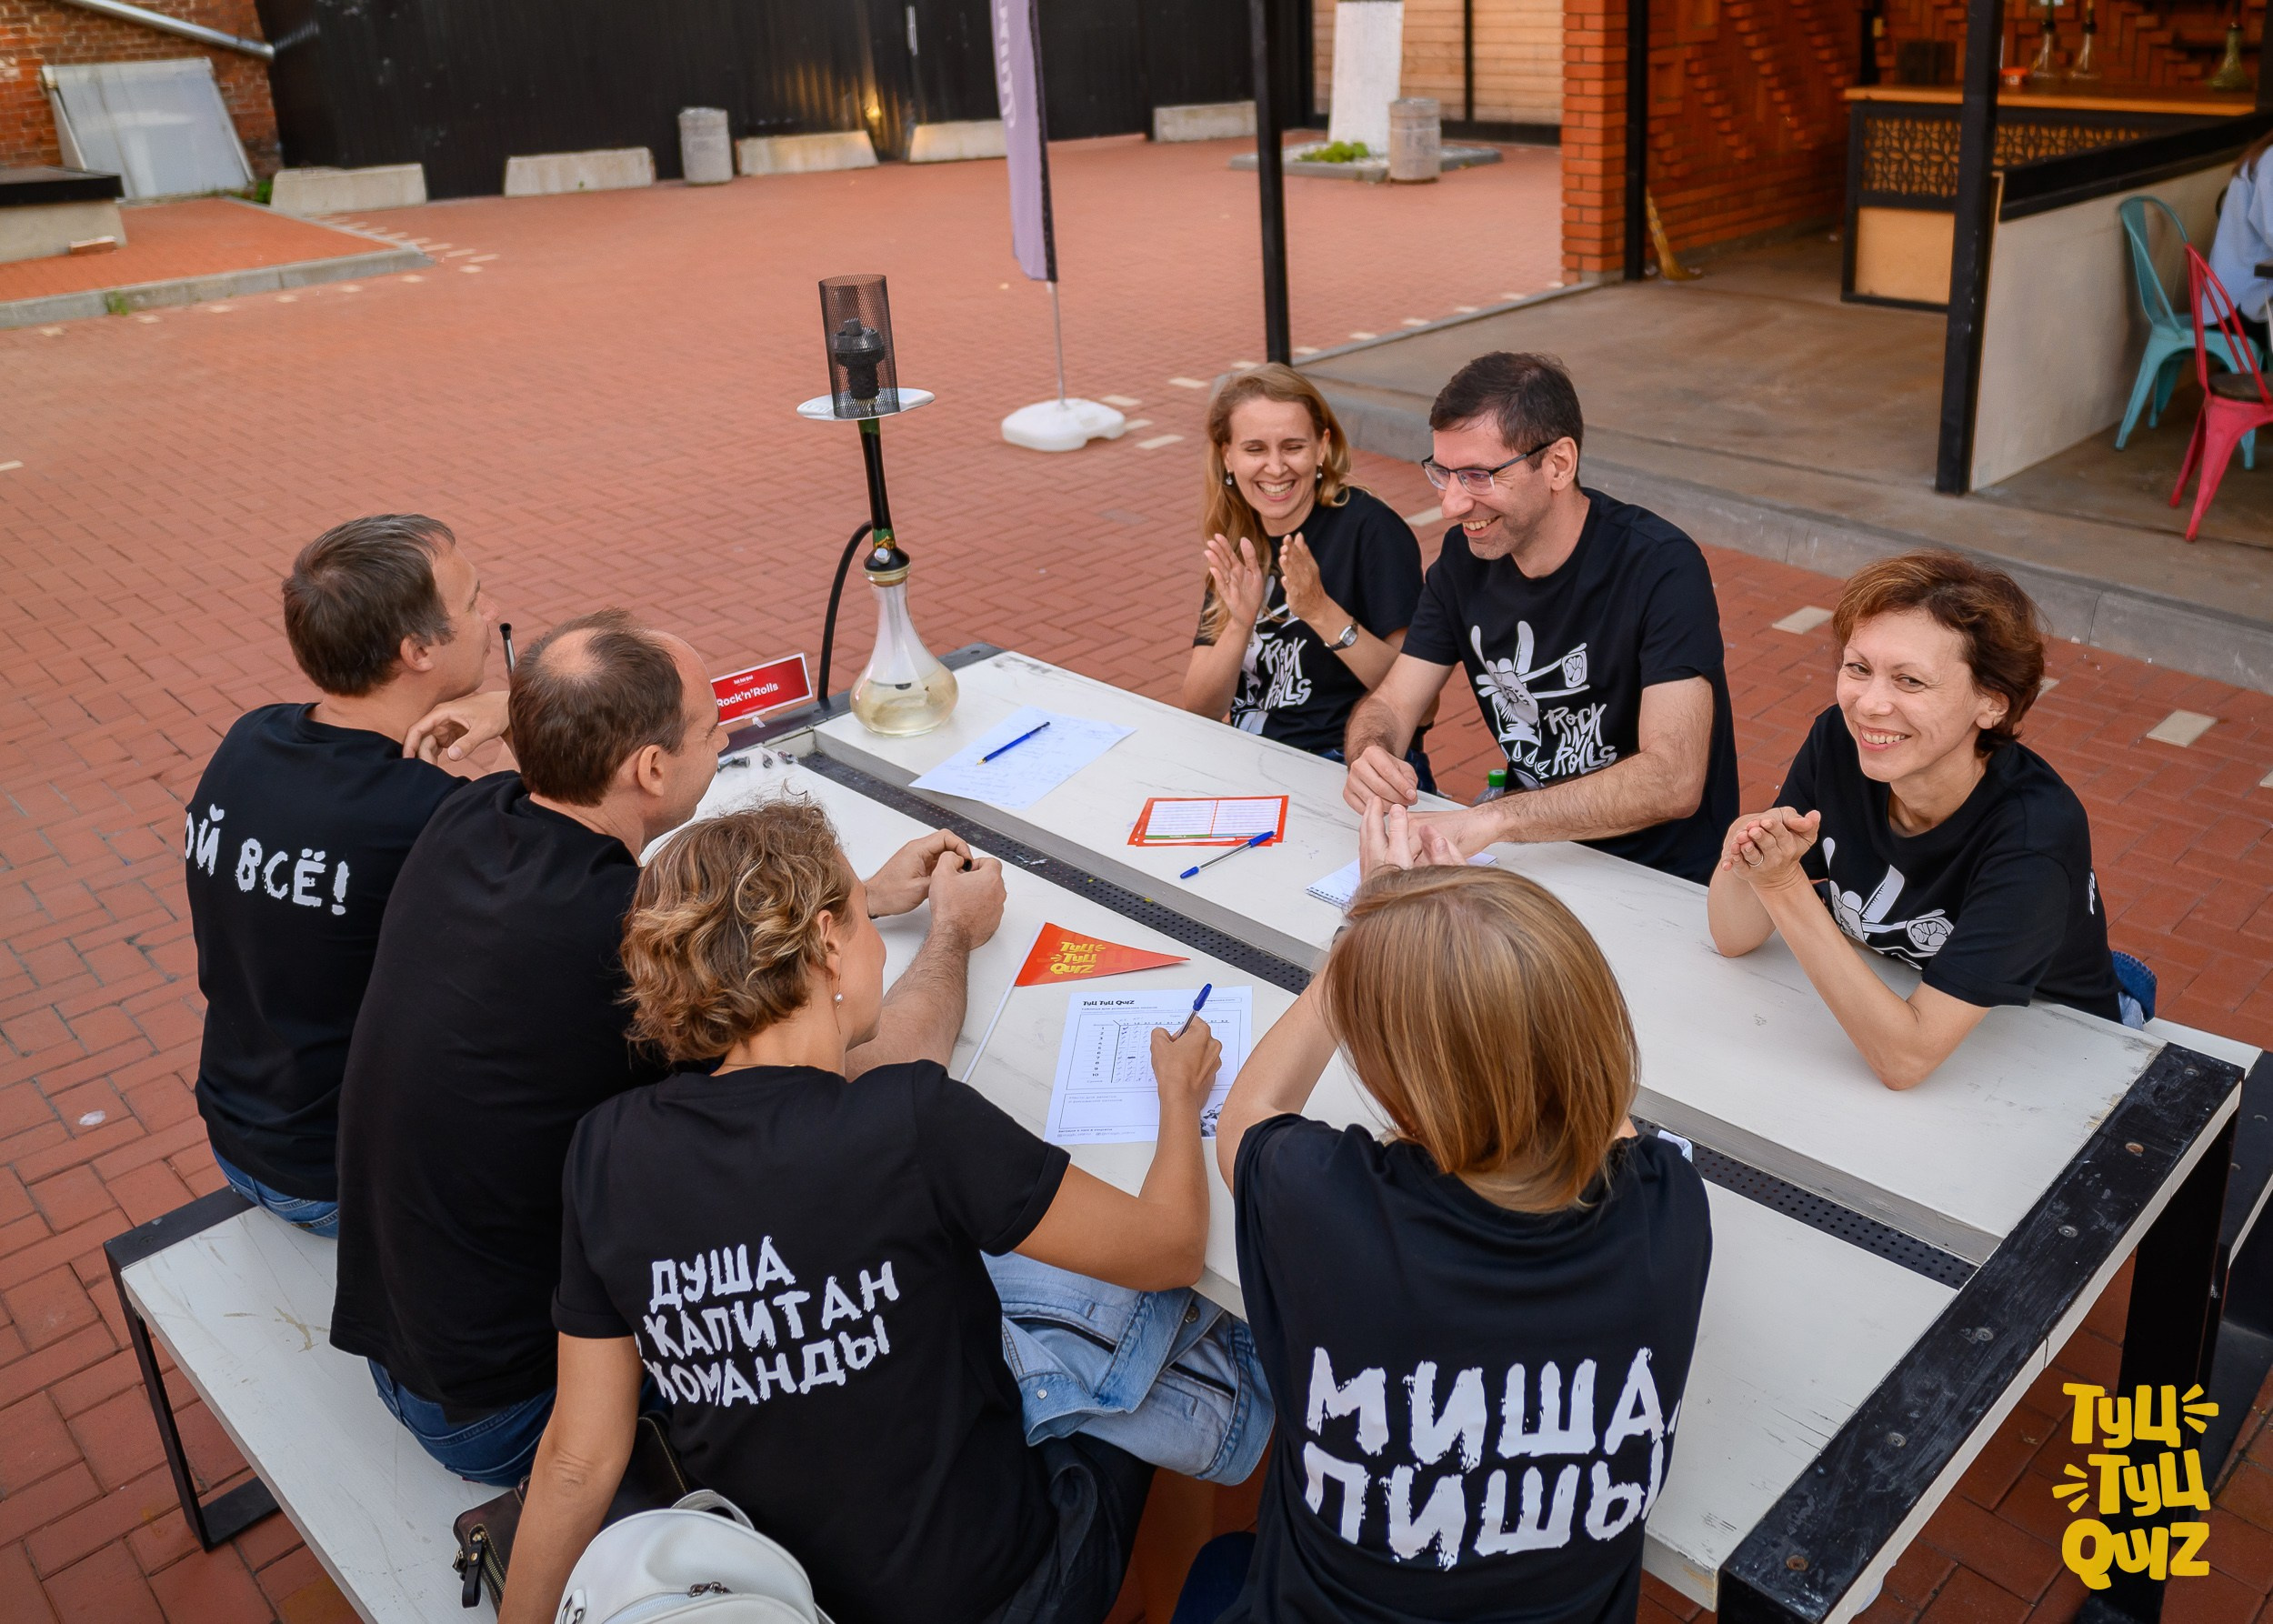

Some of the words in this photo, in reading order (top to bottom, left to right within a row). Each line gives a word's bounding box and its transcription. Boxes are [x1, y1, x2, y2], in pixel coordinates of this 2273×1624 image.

[235, 837, 350, 916] ВСЁ!
[642, 1260, 900, 1360] КАПИТАН
[650, 1235, 796, 1314] ДУША
[642, 1314, 891, 1408] КОМАНДЫ
[1304, 1435, 1664, 1572] ПИШЫ
